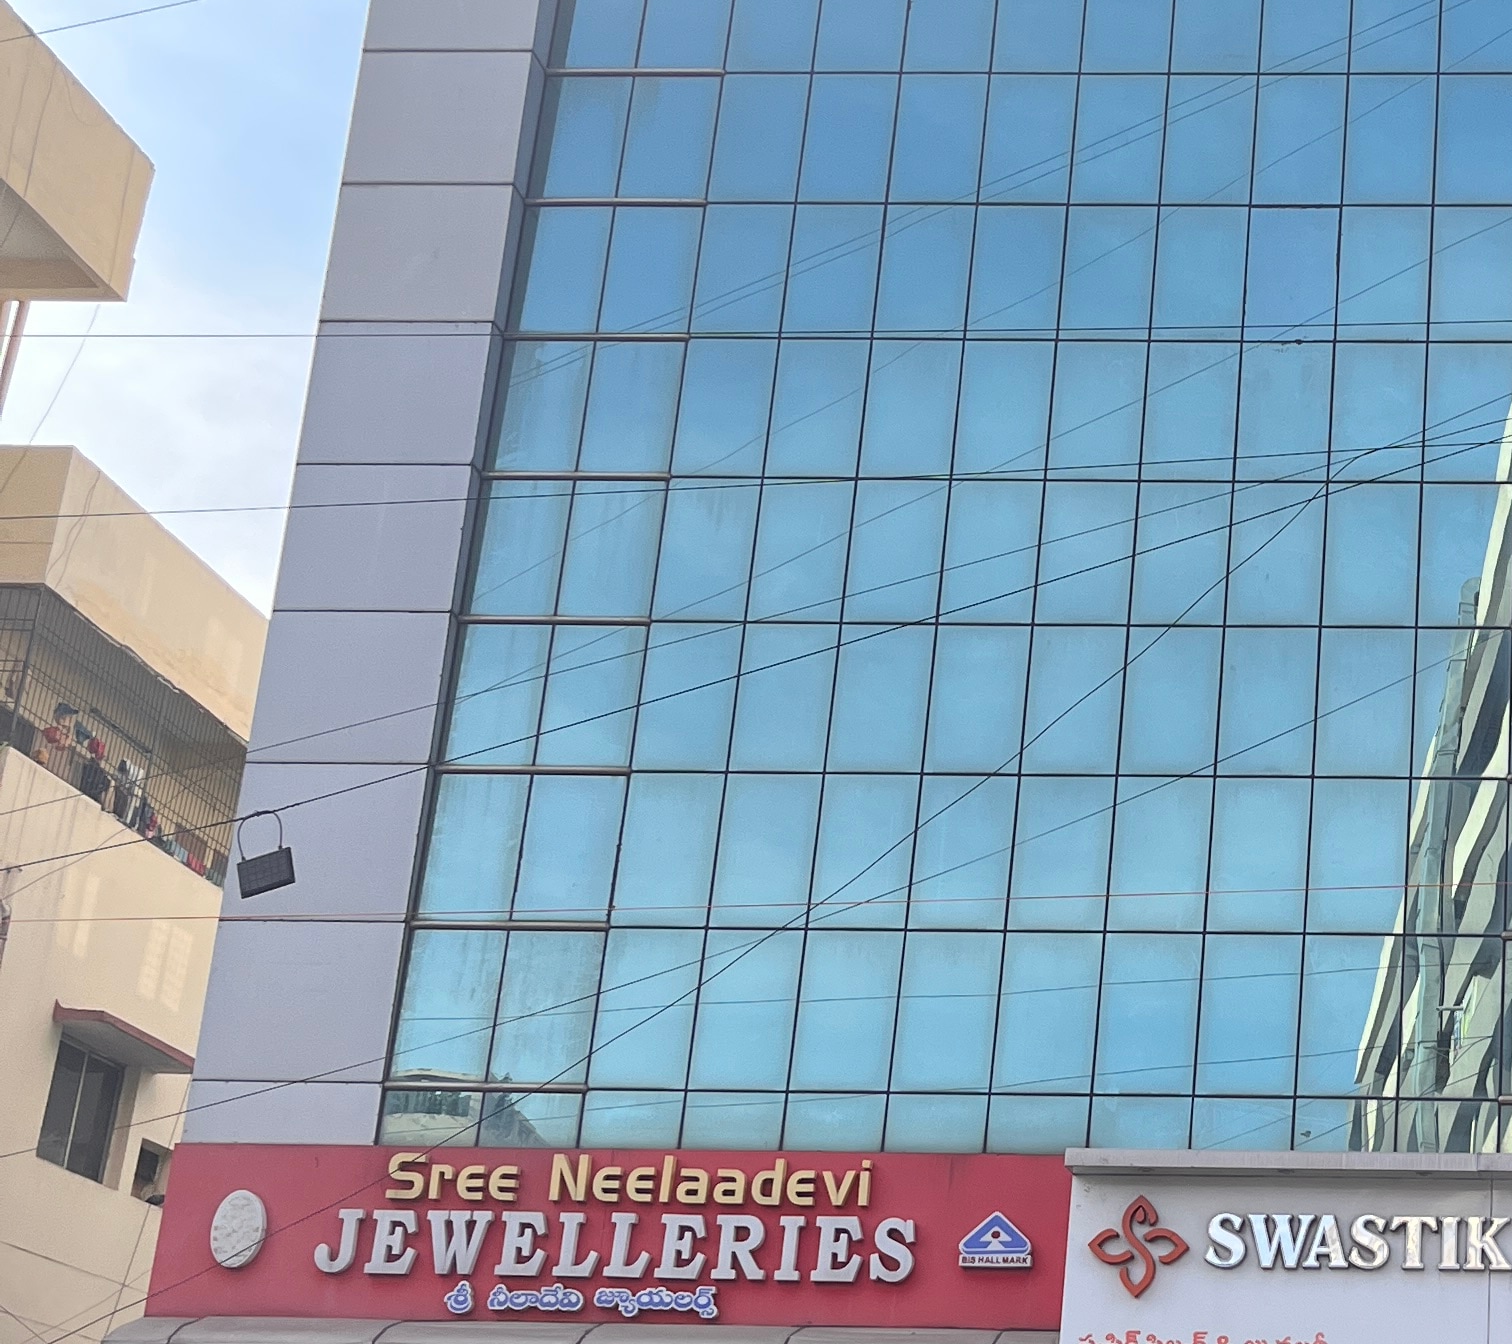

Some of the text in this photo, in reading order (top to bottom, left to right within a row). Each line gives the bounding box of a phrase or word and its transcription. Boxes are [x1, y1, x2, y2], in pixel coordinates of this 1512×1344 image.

[385, 1152, 874, 1208] Sree Neelaadevi
[313, 1208, 917, 1284] JEWELLERIES
[961, 1256, 976, 1264] BIS
[1204, 1212, 1512, 1271] SWASTIK
[444, 1280, 474, 1314] శ్రీ
[488, 1283, 583, 1311] నీలాదేవి
